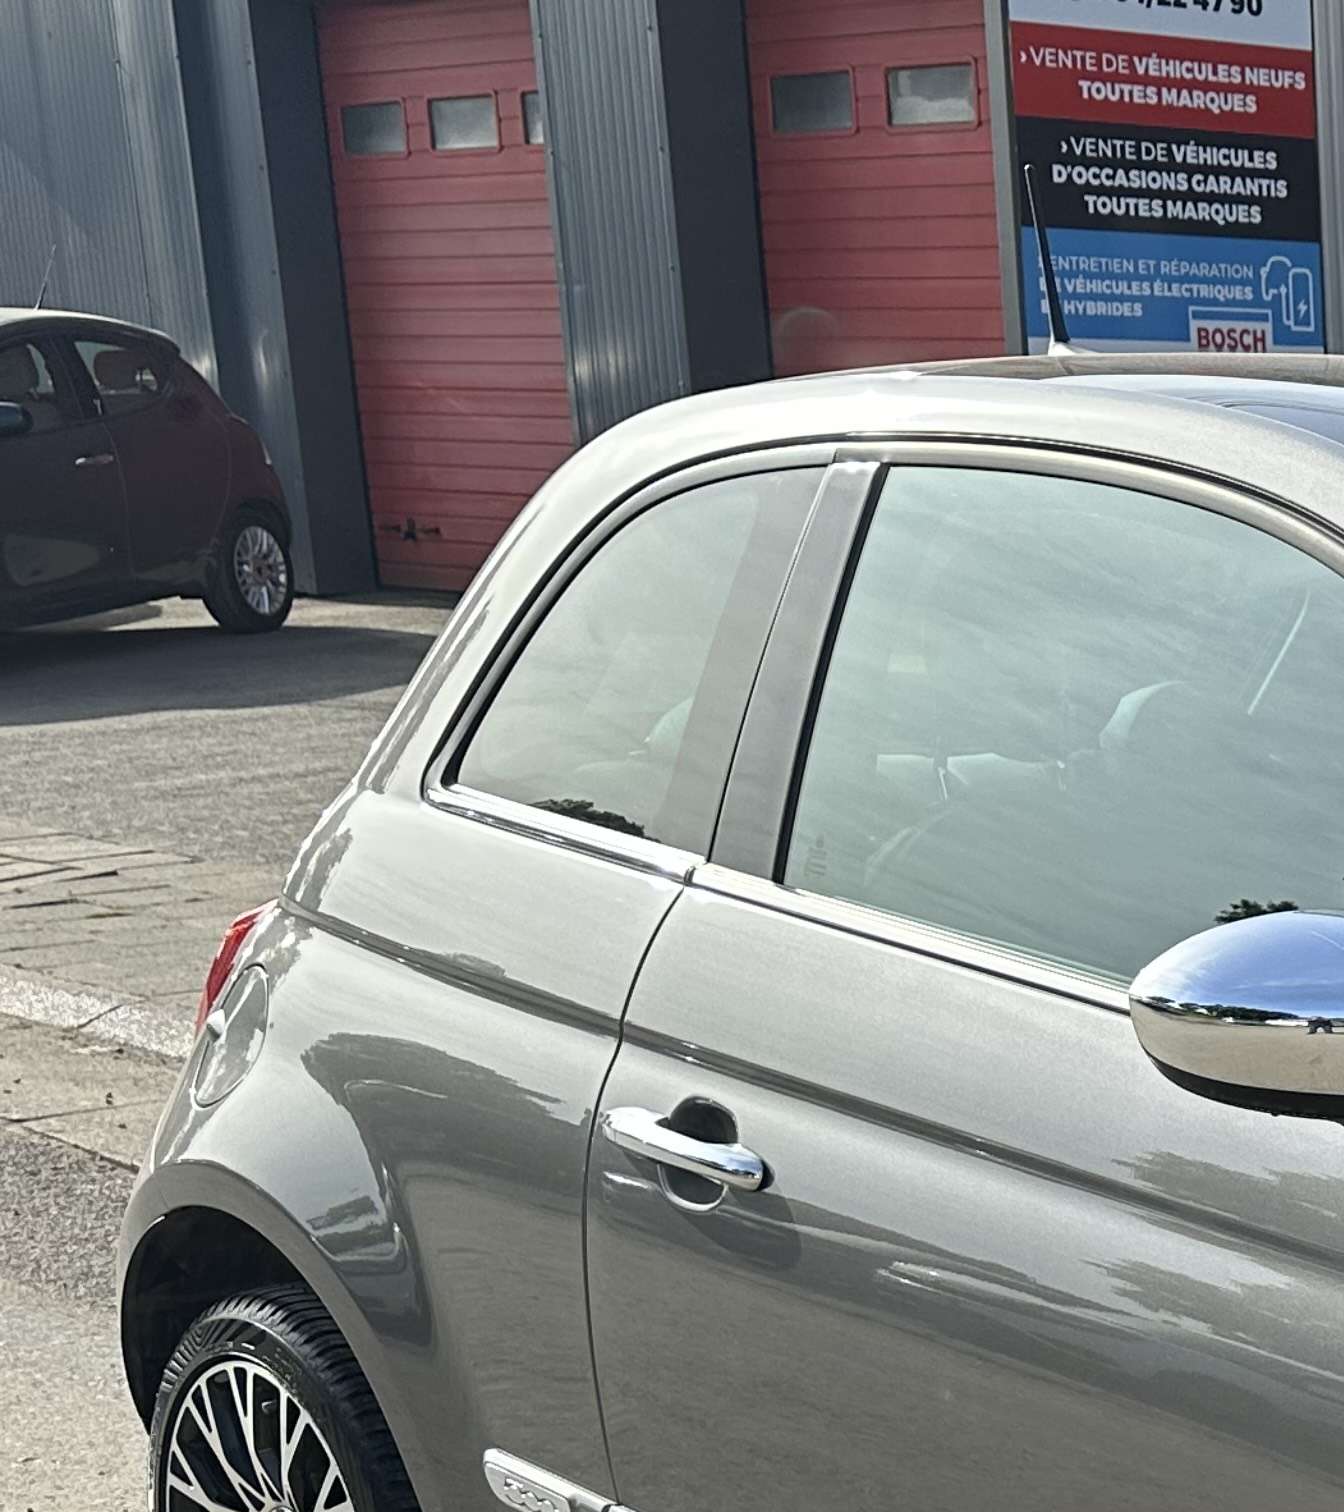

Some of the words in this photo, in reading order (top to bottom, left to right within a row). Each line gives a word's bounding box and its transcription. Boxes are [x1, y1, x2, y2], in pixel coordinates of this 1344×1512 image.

[1030, 46, 1097, 72] VENTE
[1102, 53, 1129, 74] DE
[1133, 54, 1241, 84] VÉHICULES
[1245, 67, 1306, 90] NEUFS
[1079, 80, 1158, 105] TOUTES
[1162, 85, 1257, 114] MARQUES
[1070, 136, 1136, 161] VENTE
[1140, 142, 1168, 162] DE
[1171, 142, 1277, 170] VÉHICULES
[1052, 164, 1188, 192] D'OCCASIONS
[1192, 174, 1288, 198] GARANTIS
[1084, 195, 1163, 218] TOUTES
[1166, 200, 1262, 225] MARQUES
[1050, 256, 1134, 274] ENTRETIEN
[1138, 260, 1156, 275] ET
[1160, 258, 1253, 279] RÉPARATION
[1064, 276, 1151, 295] VÉHICULES
[1153, 280, 1253, 300] ÉLECTRIQUES
[1064, 301, 1142, 317] HYBRIDES
[1197, 327, 1267, 353] BOSCH
